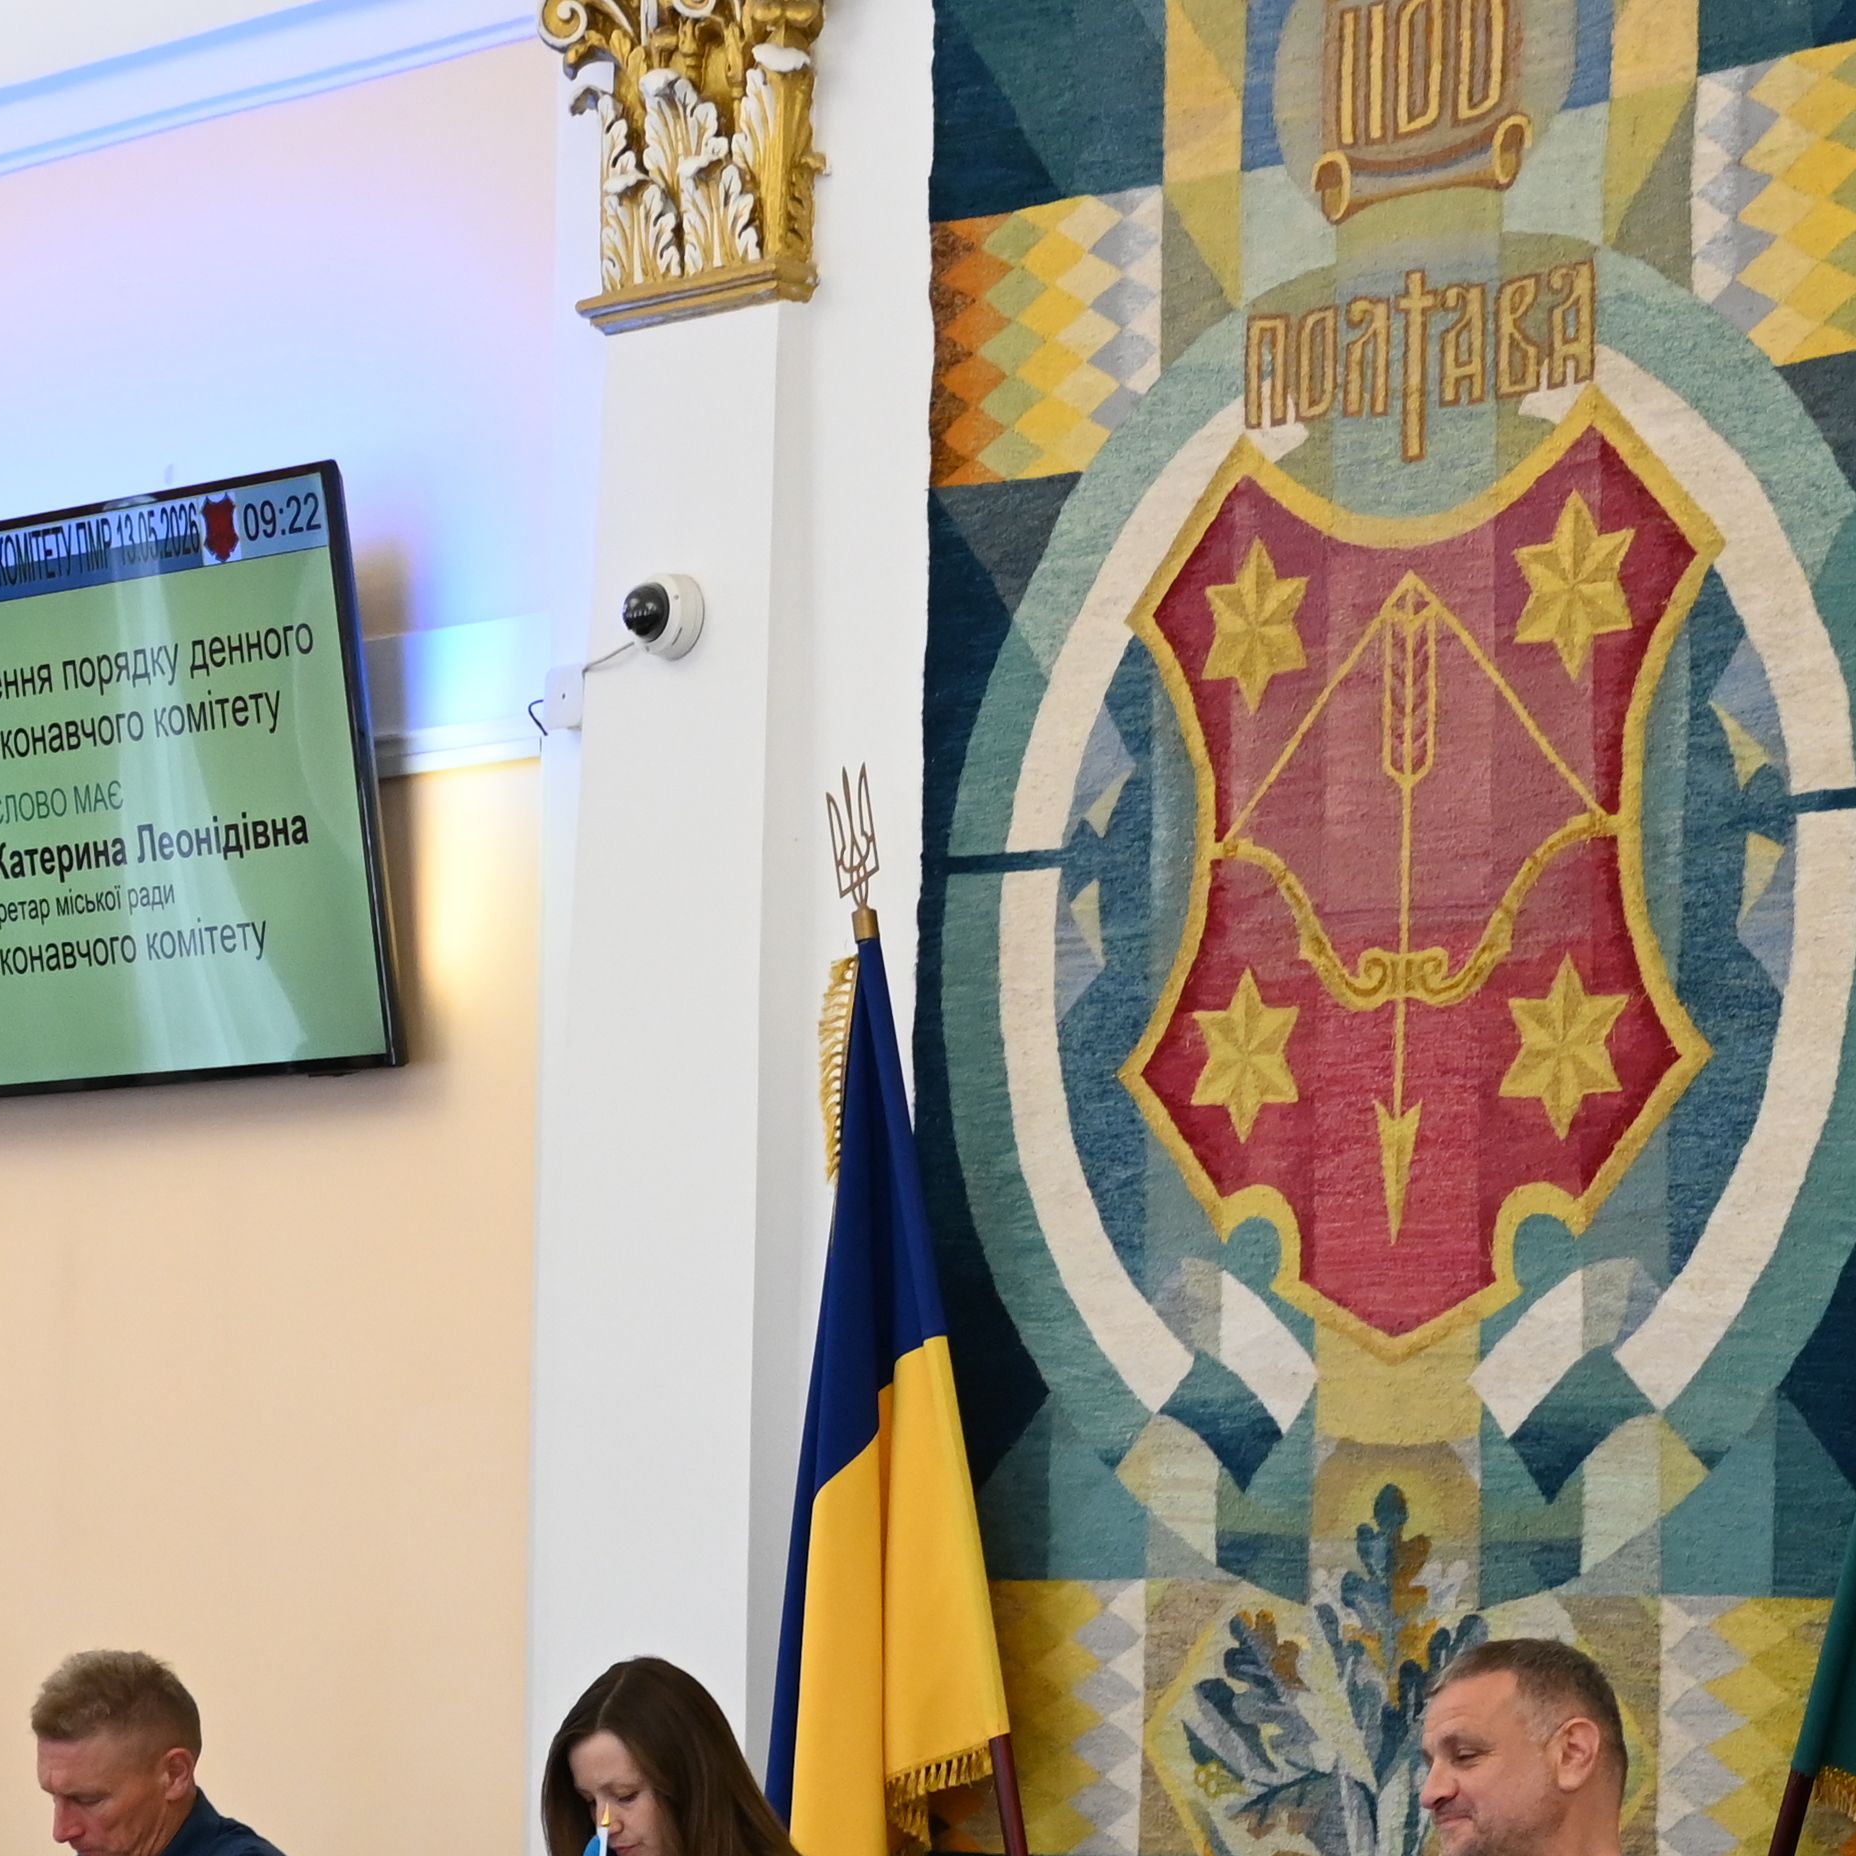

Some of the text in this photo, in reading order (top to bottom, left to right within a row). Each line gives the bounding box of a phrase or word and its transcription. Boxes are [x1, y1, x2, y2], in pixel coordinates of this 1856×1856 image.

[76, 517, 113, 573] ПМР
[116, 502, 201, 566] 13.05.2026
[243, 492, 322, 542] 09:22
[62, 643, 179, 696] порядку
[189, 623, 313, 680] денного
[154, 690, 280, 738] комітету
[73, 780, 124, 815] МАЄ
[136, 811, 310, 864] Леонідівна
[56, 884, 122, 917] міської
[127, 884, 176, 916] ради
[146, 917, 267, 961] комітету
